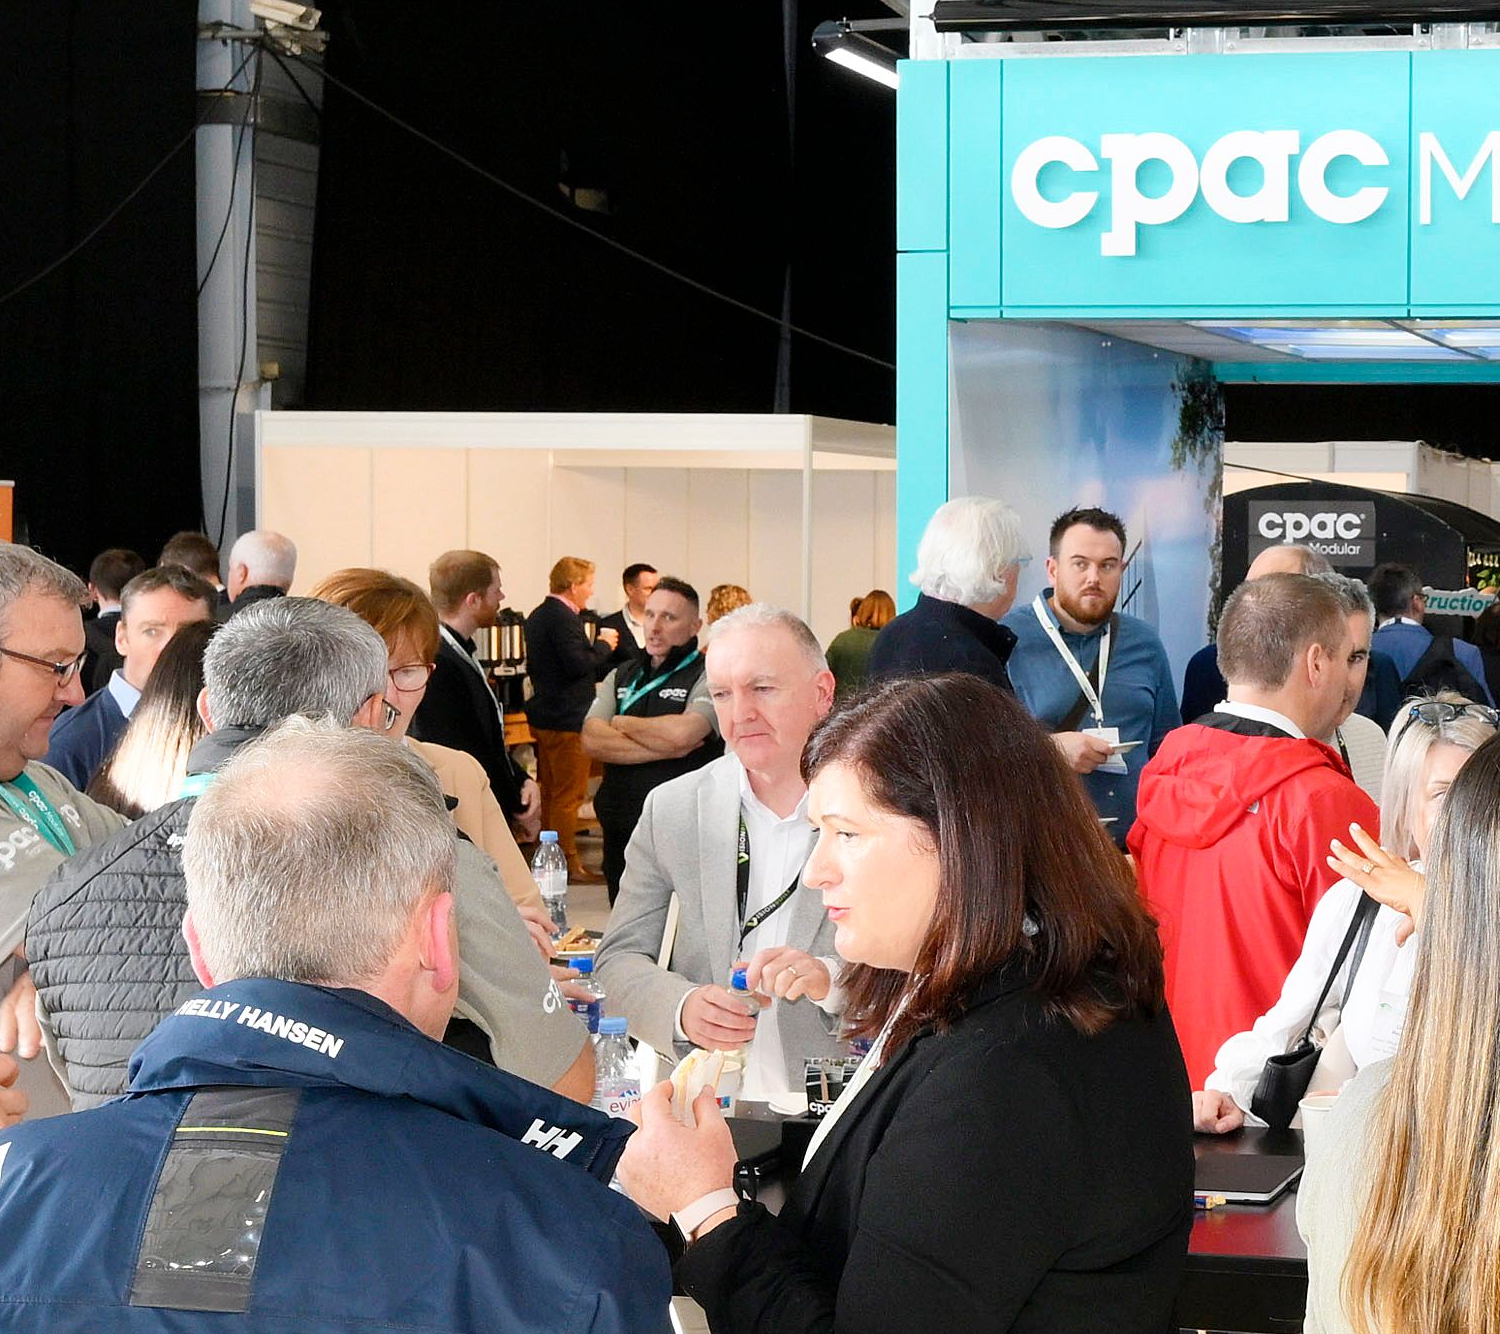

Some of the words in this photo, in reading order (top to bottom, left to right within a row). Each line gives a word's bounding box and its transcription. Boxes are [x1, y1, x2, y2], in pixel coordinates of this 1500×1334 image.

[1011, 129, 1389, 257] cpac
[1258, 512, 1362, 544] cpac
[1308, 543, 1361, 555] Modular
[174, 998, 240, 1020] HELLY
[237, 1005, 344, 1059] HANSEN
[809, 1101, 836, 1115] cpa
[521, 1118, 583, 1160] HH
